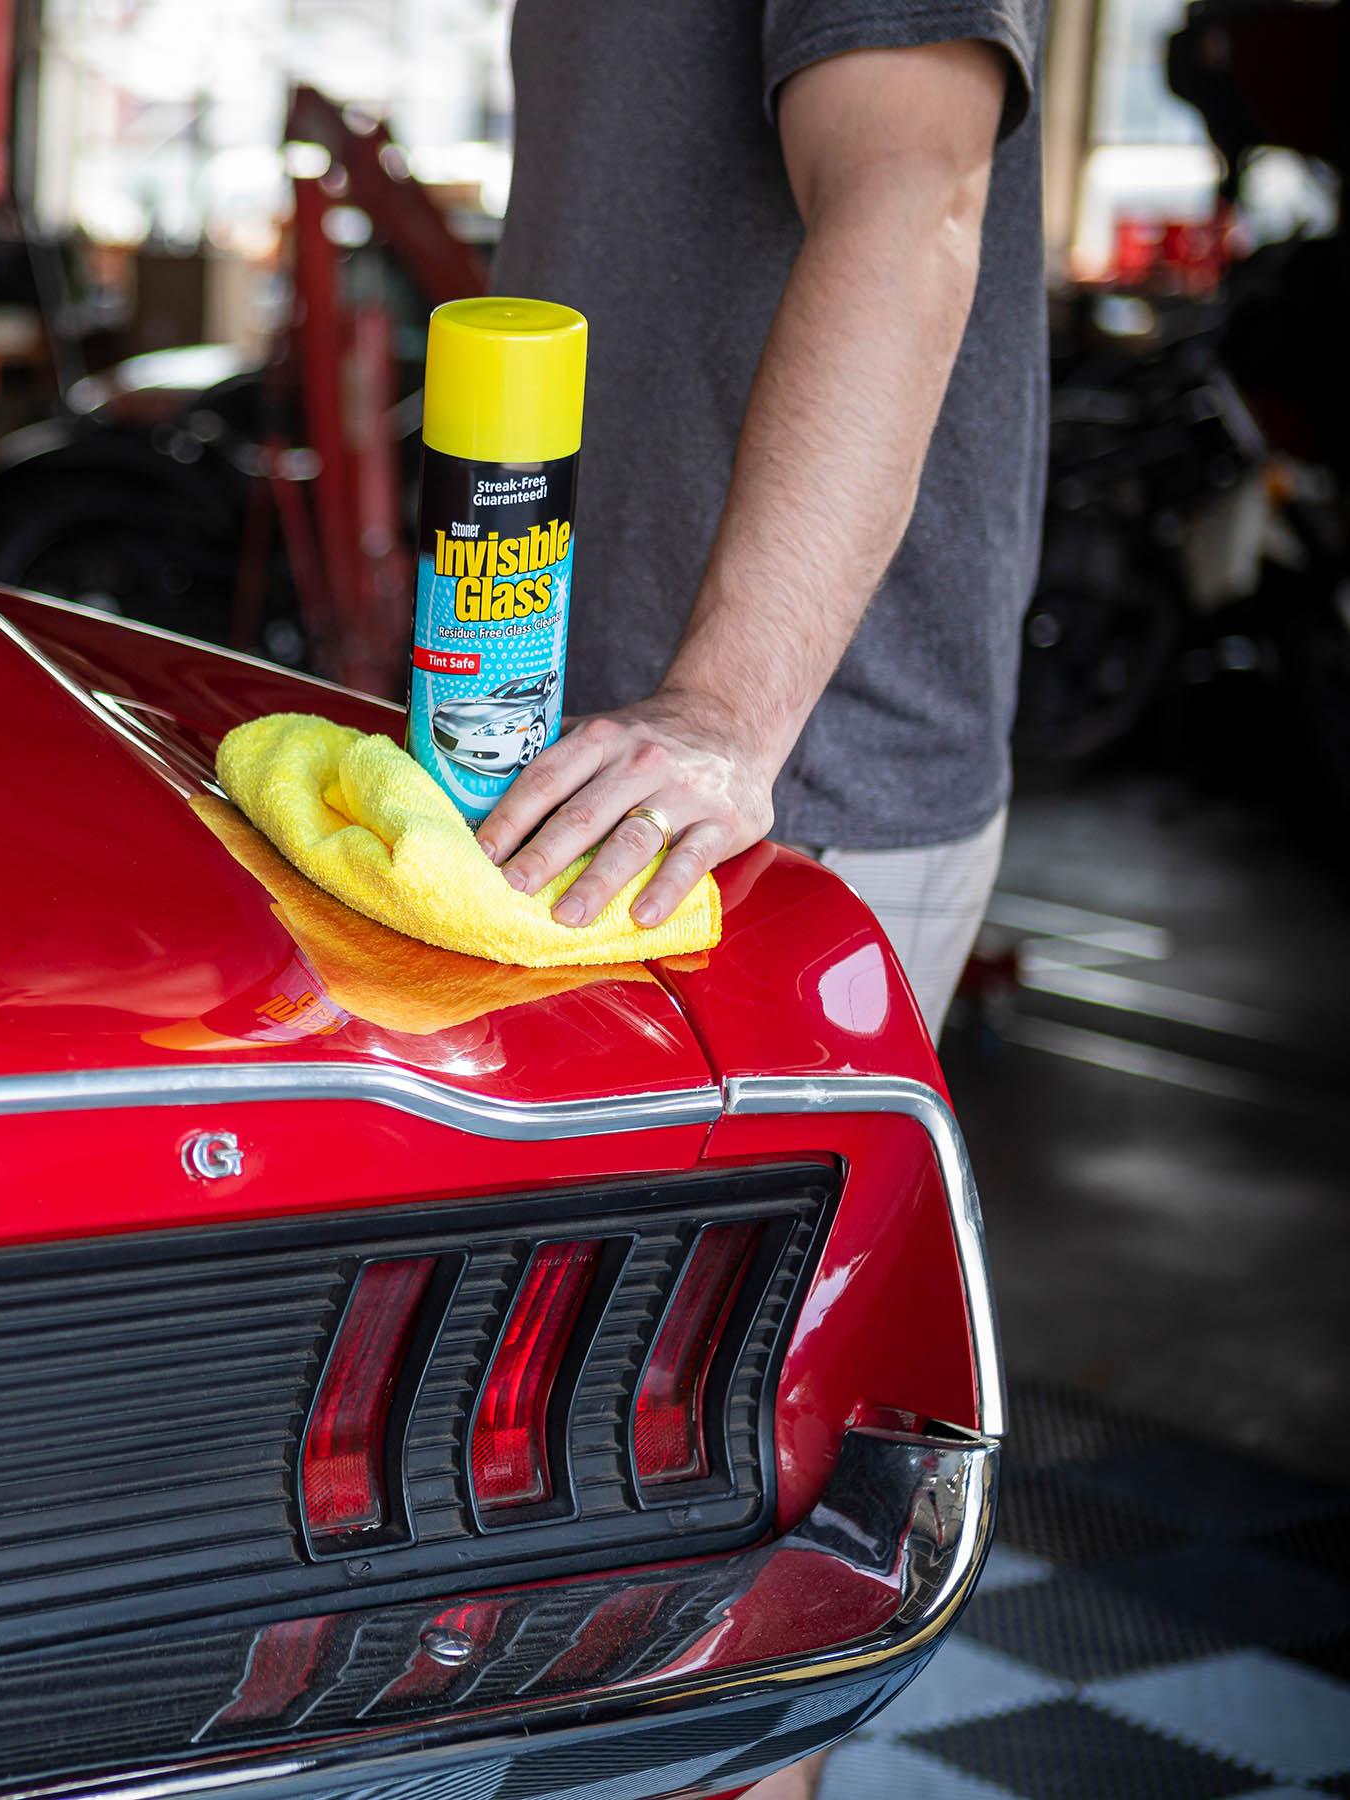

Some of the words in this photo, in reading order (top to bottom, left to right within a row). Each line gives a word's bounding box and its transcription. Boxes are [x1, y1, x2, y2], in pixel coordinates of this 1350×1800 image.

[477, 475, 546, 493] Streak-Free
[473, 485, 548, 506] Guaranteed!
[451, 522, 480, 538] Stoner
[435, 518, 571, 577] Invisible
[454, 573, 552, 622] Glass
[438, 626, 476, 639] Residue
[479, 628, 502, 639] Free
[505, 623, 532, 636] Glass
[428, 654, 447, 668] Tint
[449, 657, 475, 670] Safe
